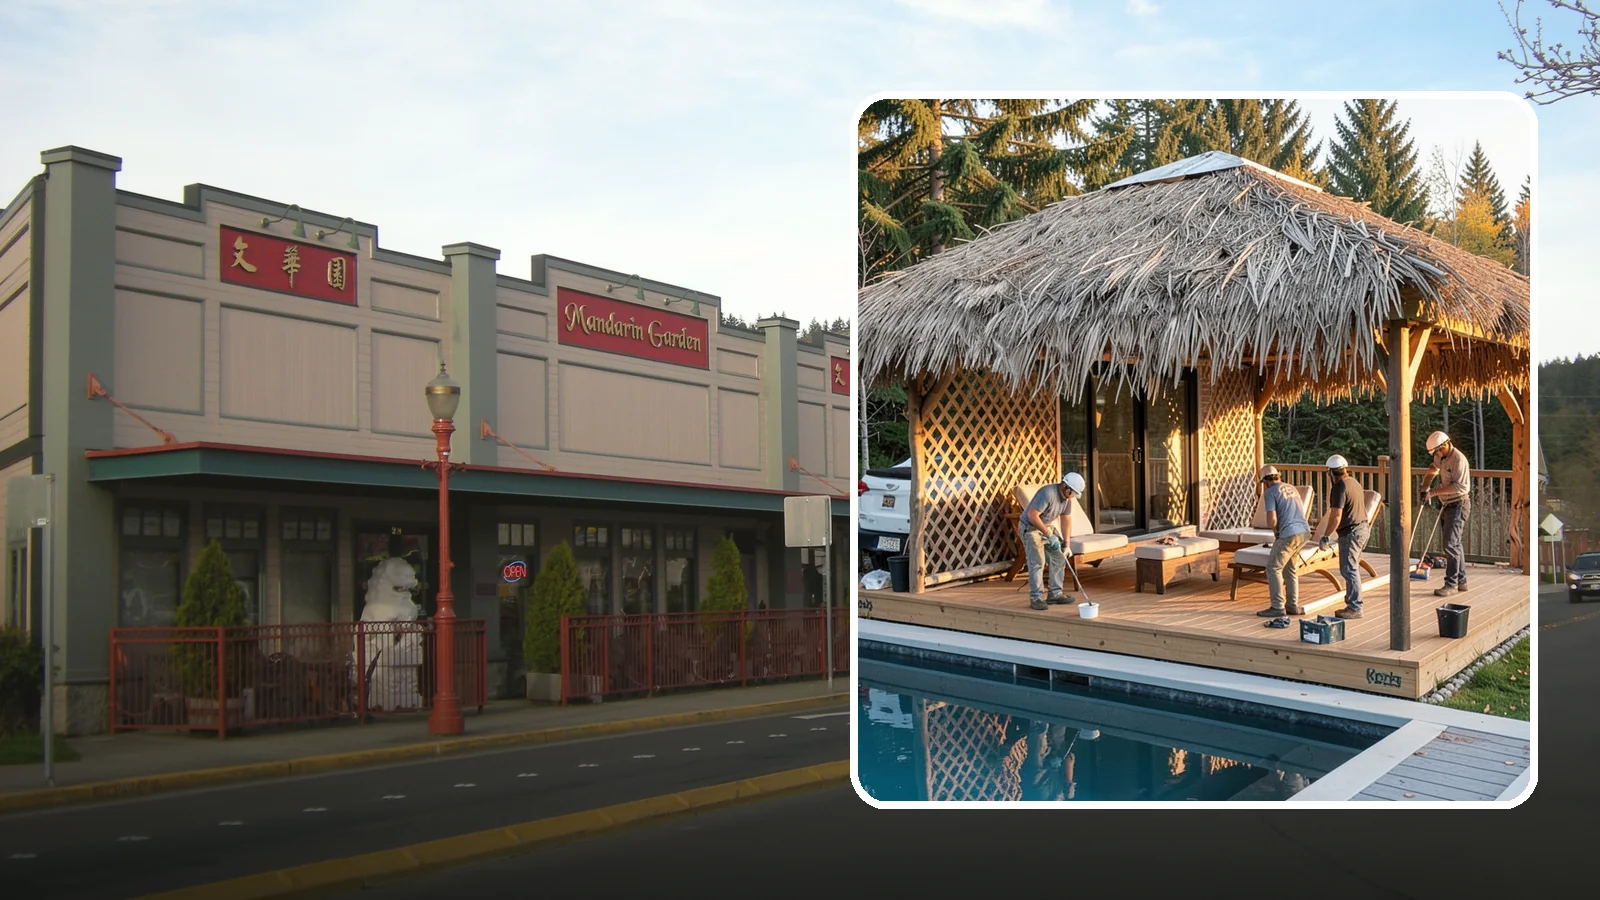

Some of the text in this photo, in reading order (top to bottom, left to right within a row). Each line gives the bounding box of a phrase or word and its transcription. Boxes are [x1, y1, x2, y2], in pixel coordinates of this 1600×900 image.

[231, 236, 346, 291] 文華園
[564, 302, 701, 352] Mandarin Garden
[503, 565, 527, 579] OPEN
